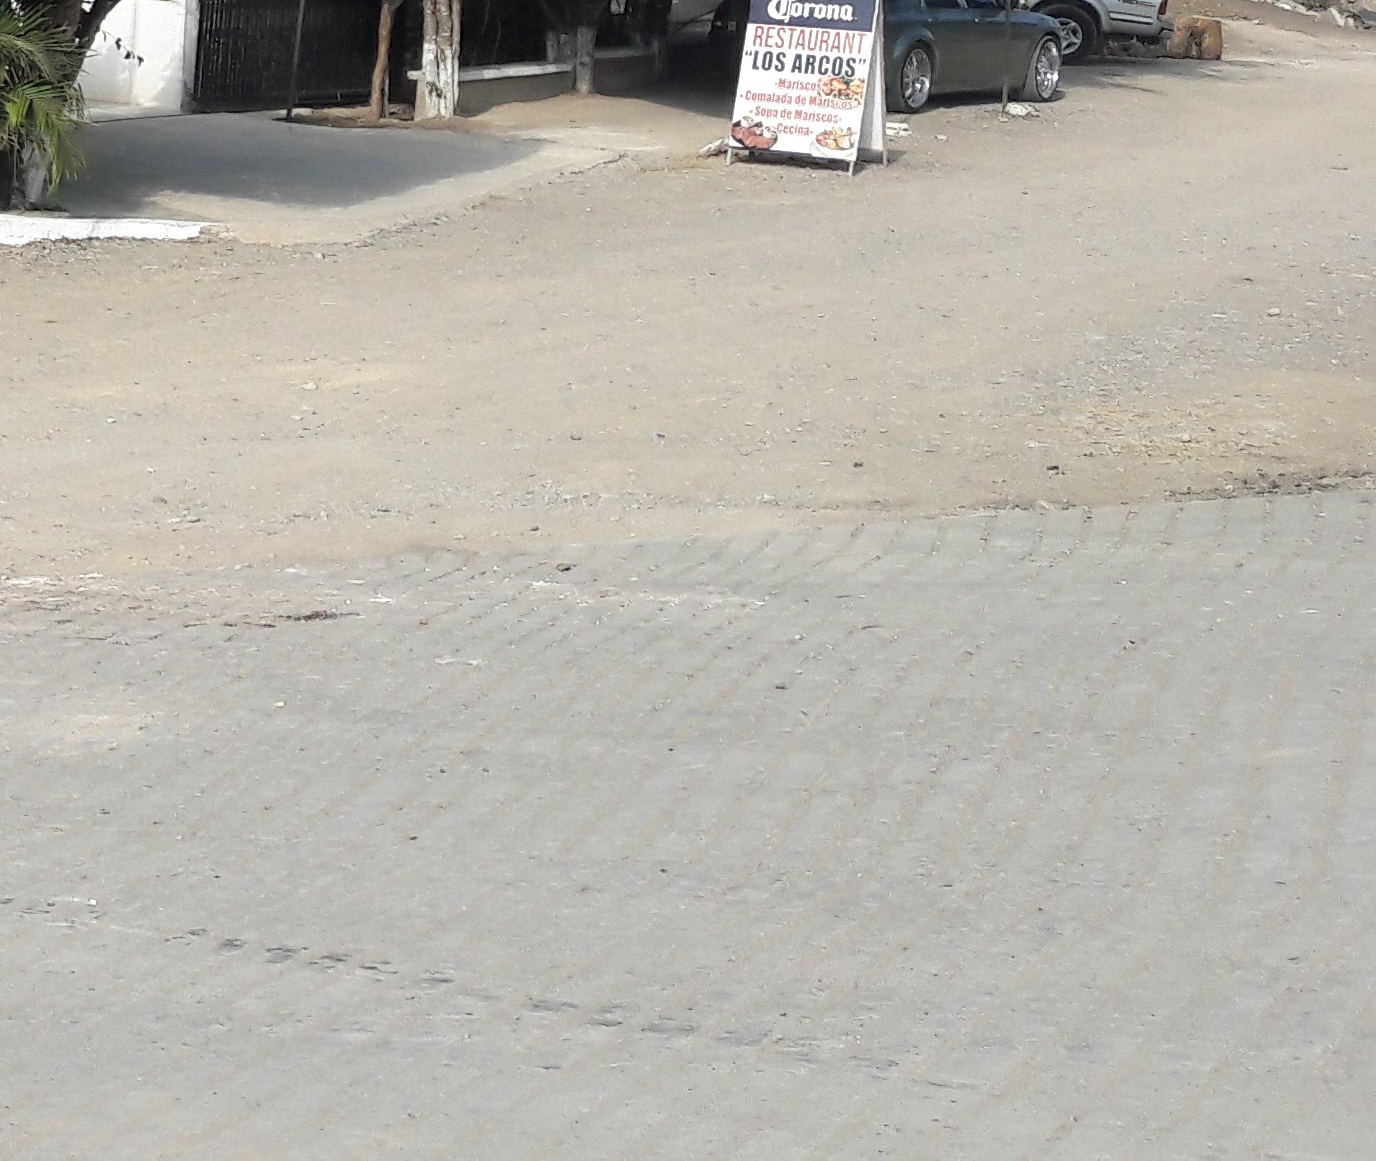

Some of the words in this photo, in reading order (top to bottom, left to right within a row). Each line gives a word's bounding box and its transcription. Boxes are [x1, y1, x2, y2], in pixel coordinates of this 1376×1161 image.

[752, 25, 867, 55] RESTAURANT
[795, 94, 807, 105] de
[755, 105, 778, 119] Sopa
[780, 109, 792, 120] de
